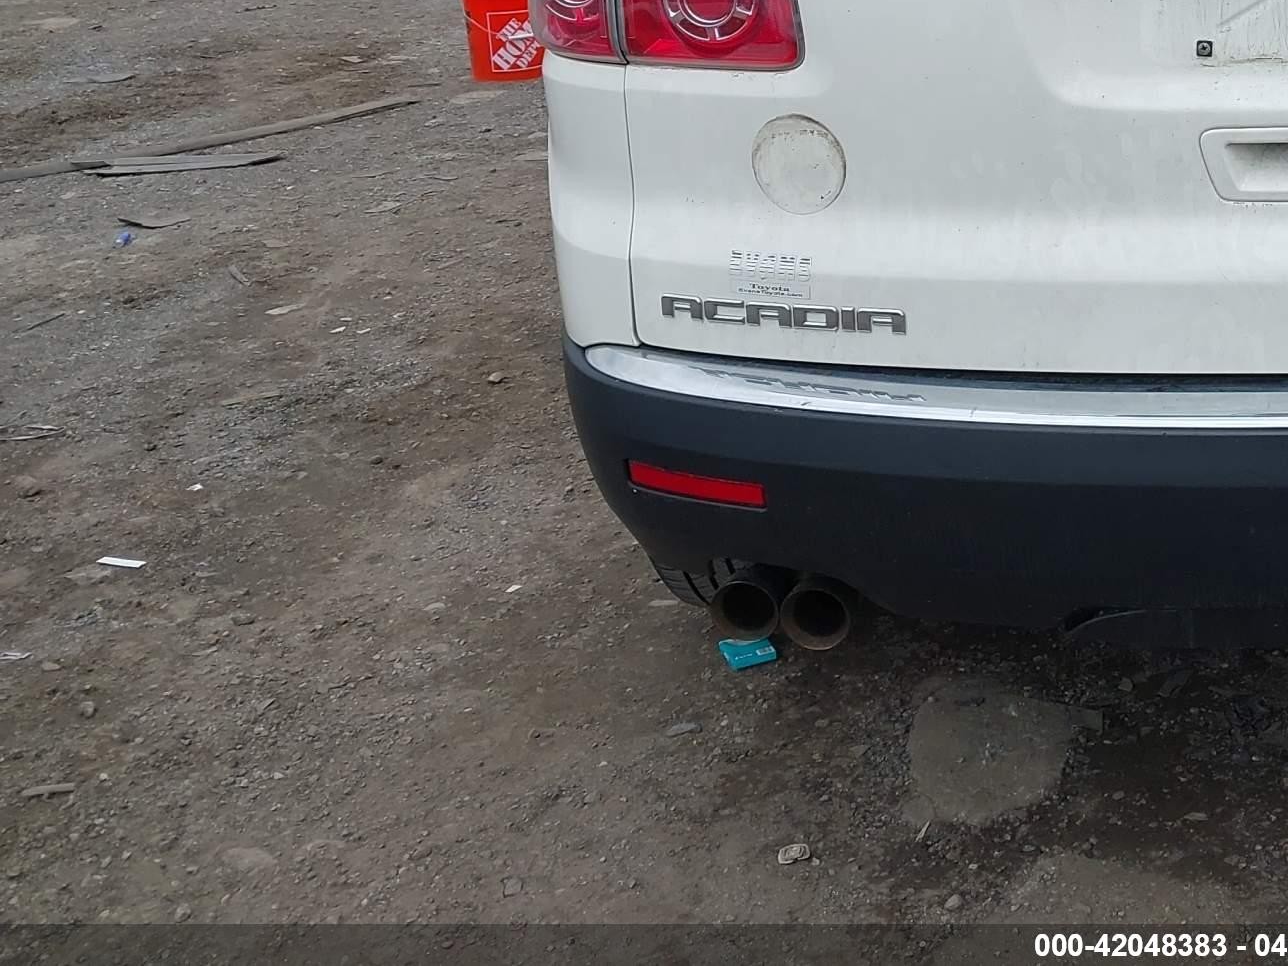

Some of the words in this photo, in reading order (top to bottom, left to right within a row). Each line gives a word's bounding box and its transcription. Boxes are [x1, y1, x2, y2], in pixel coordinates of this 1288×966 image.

[496, 18, 521, 42] THE
[749, 282, 790, 292] Toyota
[661, 293, 907, 335] ACADIA
